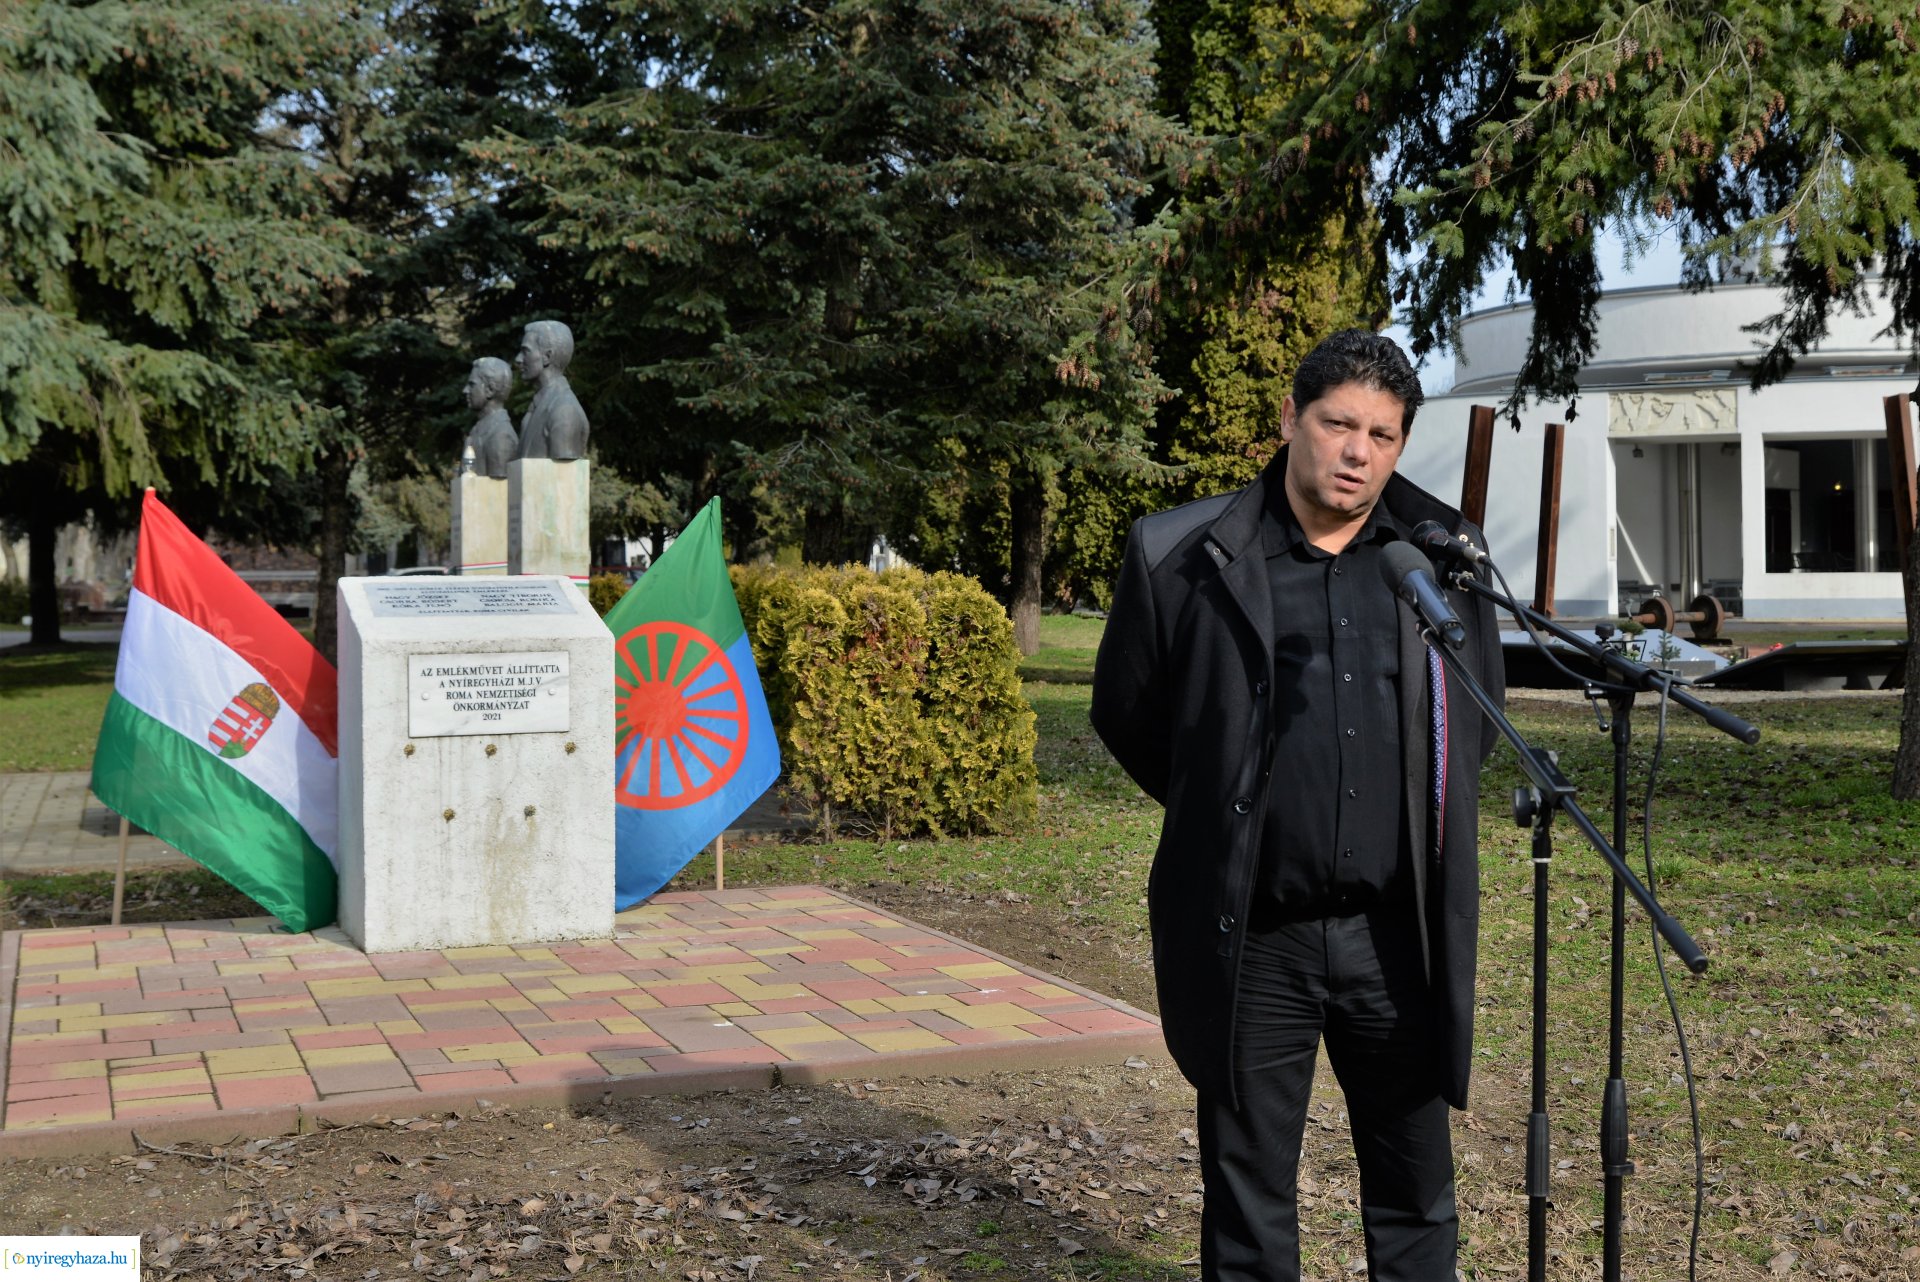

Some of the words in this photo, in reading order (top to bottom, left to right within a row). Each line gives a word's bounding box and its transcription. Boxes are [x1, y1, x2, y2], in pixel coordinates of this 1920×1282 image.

[420, 668, 433, 676] AZ
[436, 666, 503, 676] EMLÉKMŰVET
[506, 664, 561, 674] ÁLLÍTTATTA
[439, 680, 446, 688] A
[449, 677, 514, 688] NYÍREGYHÁZI
[446, 691, 473, 700] ROMA
[476, 688, 537, 698] NEMZETISÉGI
[453, 701, 530, 712] ÖNKORMÁNYZAT
